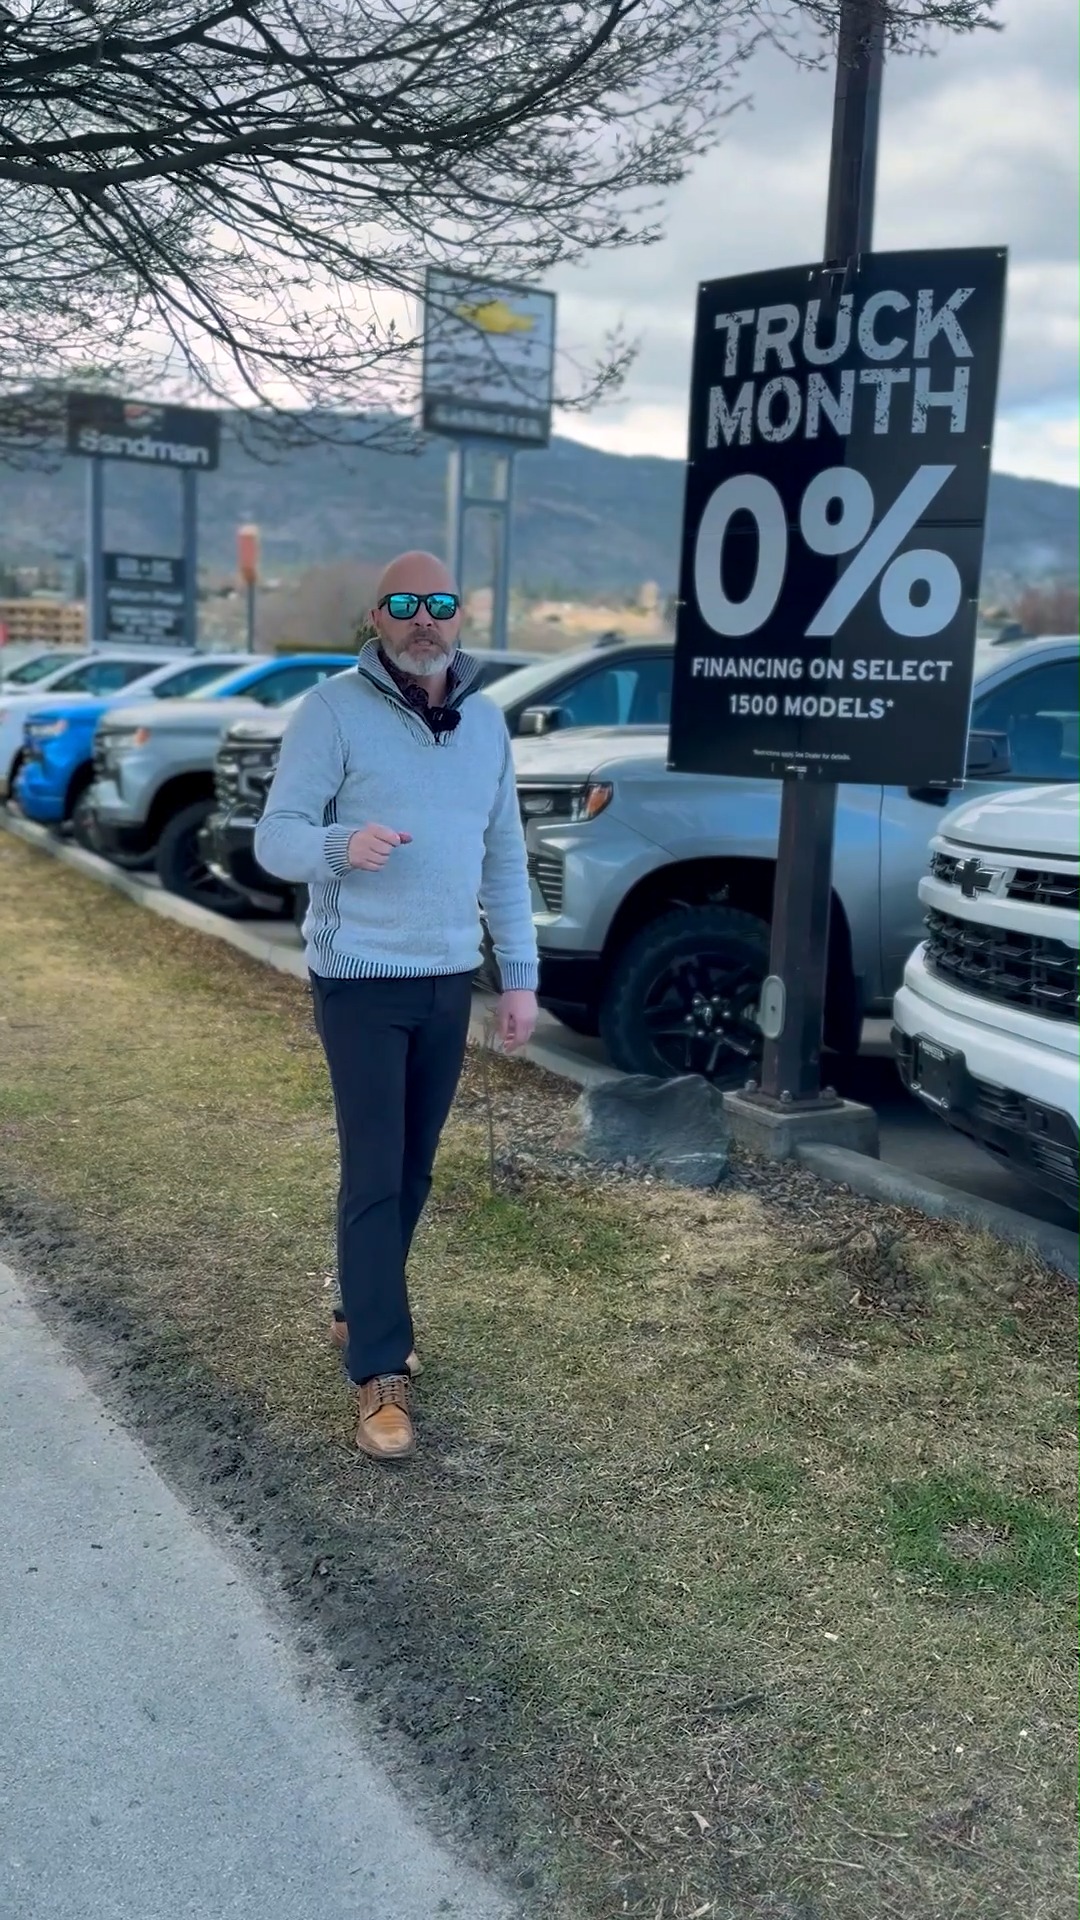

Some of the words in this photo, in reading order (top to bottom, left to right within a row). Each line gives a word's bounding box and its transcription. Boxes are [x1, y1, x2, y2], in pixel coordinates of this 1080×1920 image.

[714, 288, 976, 377] TRUCK
[707, 366, 970, 449] MONTH
[78, 427, 209, 465] Sandman
[694, 465, 962, 637] 0%
[691, 656, 803, 679] FINANCING
[809, 657, 844, 680] ON
[852, 659, 953, 682] SELECT
[729, 694, 778, 715] 1500
